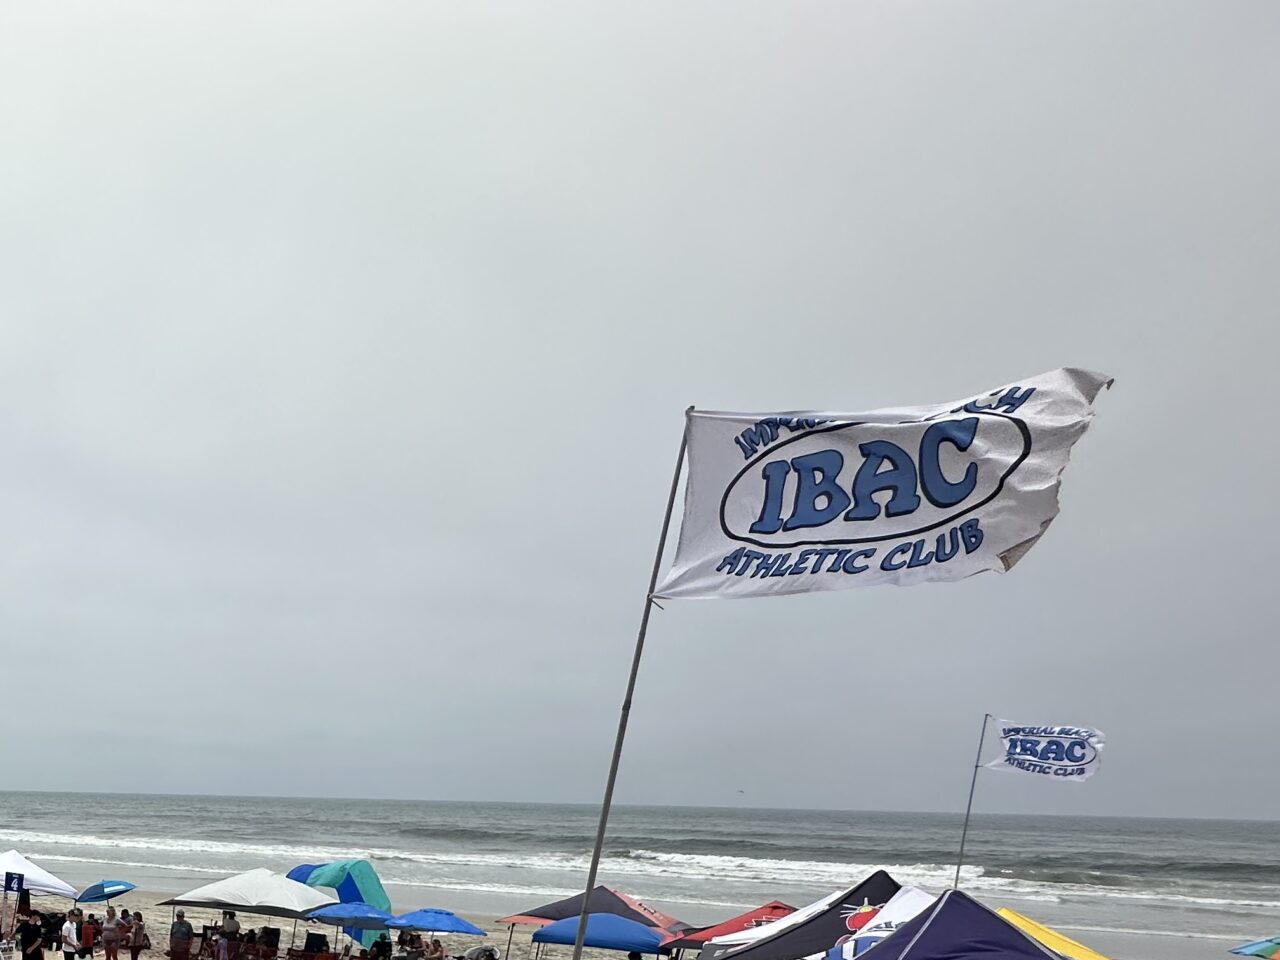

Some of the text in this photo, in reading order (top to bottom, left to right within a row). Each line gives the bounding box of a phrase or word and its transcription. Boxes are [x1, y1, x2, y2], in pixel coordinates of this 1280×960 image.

[748, 416, 980, 535] IBAC
[716, 517, 984, 579] ATHLETIC CLUB
[1002, 726, 1097, 741] IMPERIAL BEACH
[1006, 737, 1087, 763] IBAC
[1004, 756, 1086, 777] ATHLETIC CLUB
[10, 878, 19, 891] 4
